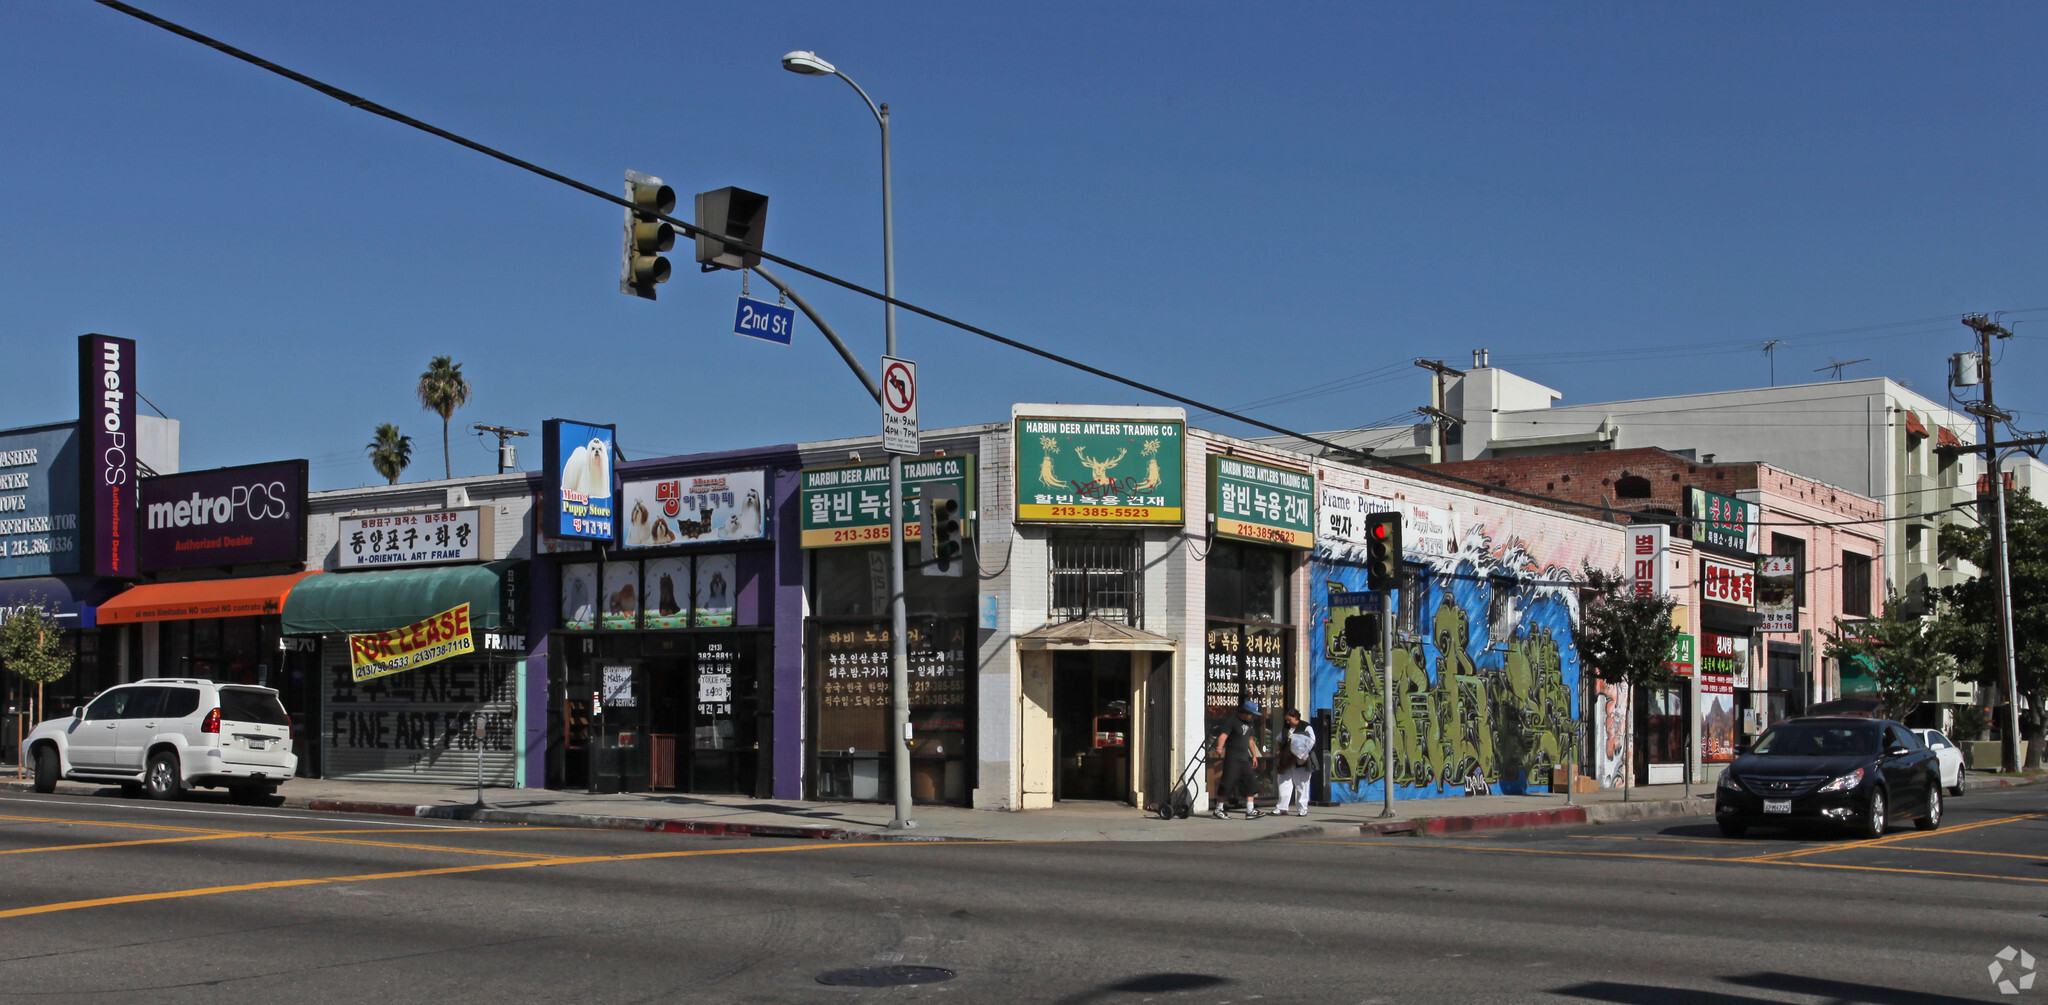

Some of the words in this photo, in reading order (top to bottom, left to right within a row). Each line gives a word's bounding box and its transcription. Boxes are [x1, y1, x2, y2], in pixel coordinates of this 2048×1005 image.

[741, 305, 769, 331] 2nd
[772, 315, 787, 335] St
[104, 342, 126, 485] metroPCS
[885, 413, 898, 424] 7AM
[902, 416, 916, 427] 9AM
[885, 425, 899, 436] 4PM
[903, 428, 917, 439] 7PM
[1026, 422, 1057, 434] HARBIN
[1060, 423, 1081, 434] DEER
[1084, 424, 1121, 435] ANTLERS
[1124, 425, 1159, 436] TRADING
[0, 449, 38, 467] ASHER
[0, 472, 29, 489] RYER
[809, 471, 839, 486] HARBIN
[841, 469, 861, 484] DEER
[864, 467, 890, 482] ANTLE
[904, 463, 942, 478] TRADING
[1221, 460, 1241, 476] HARBIN
[1242, 464, 1256, 480] DEER
[1257, 468, 1279, 484] ANTLERS
[1280, 473, 1301, 488] TRADING
[148, 481, 286, 530] metroPCS
[562, 489, 589, 505] Mung
[683, 491, 735, 512] 애견카페
[1034, 494, 1074, 505] 할빈
[1127, 495, 1165, 506] 건재
[1222, 482, 1251, 516] 할빈
[1254, 488, 1281, 520] 녹용
[1284, 495, 1309, 526] 건재
[1322, 489, 1351, 510] Frame
[562, 501, 588, 517] Puppy
[589, 503, 611, 517] Store
[810, 491, 853, 525] 할빈
[1052, 507, 1149, 518] 213-385-5523
[1330, 514, 1352, 537] 액자
[175, 537, 222, 551] Authorized
[224, 535, 254, 547] Dealer
[112, 540, 120, 571] Dealer
[411, 552, 427, 560] ART
[431, 549, 460, 559] FRAME
[1333, 594, 1366, 605] Western
[189, 607, 199, 615] NO
[201, 605, 219, 614] social
[233, 603, 261, 612] contrato
[352, 632, 396, 663] FOR
[397, 606, 470, 652] LEASE
[485, 633, 526, 651] FRAME
[709, 643, 723, 652] (213)
[332, 711, 389, 748] FINE
[395, 711, 440, 748] ART
